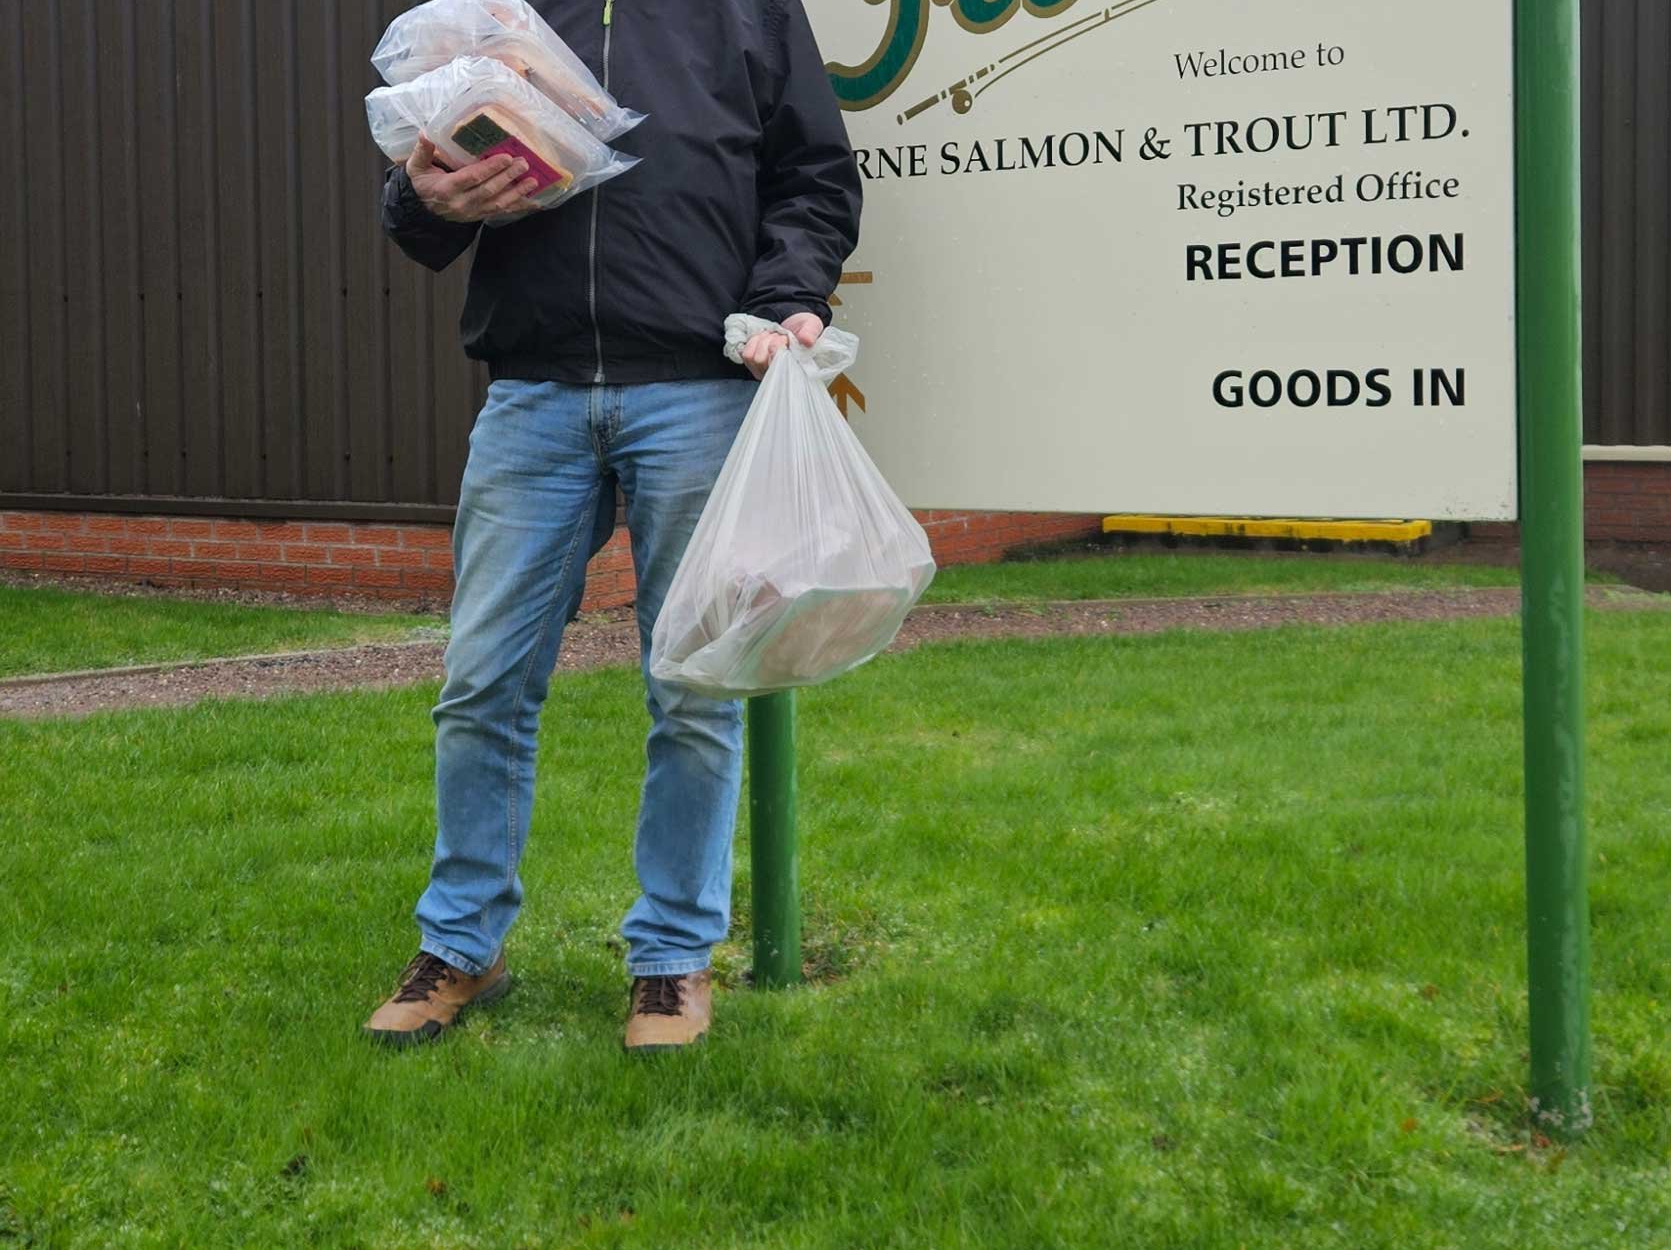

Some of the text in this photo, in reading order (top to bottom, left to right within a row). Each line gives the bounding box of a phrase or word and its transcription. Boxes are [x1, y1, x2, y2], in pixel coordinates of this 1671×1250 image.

[1173, 42, 1346, 80] Welcome to
[940, 127, 1126, 176] SALMON
[1137, 125, 1173, 162] &
[1183, 110, 1348, 158] TROUT
[1361, 102, 1471, 146] LTD.
[1176, 170, 1461, 218] Registered Office
[1185, 232, 1465, 282] RECEPTION
[1211, 366, 1467, 409] GOODS IN
